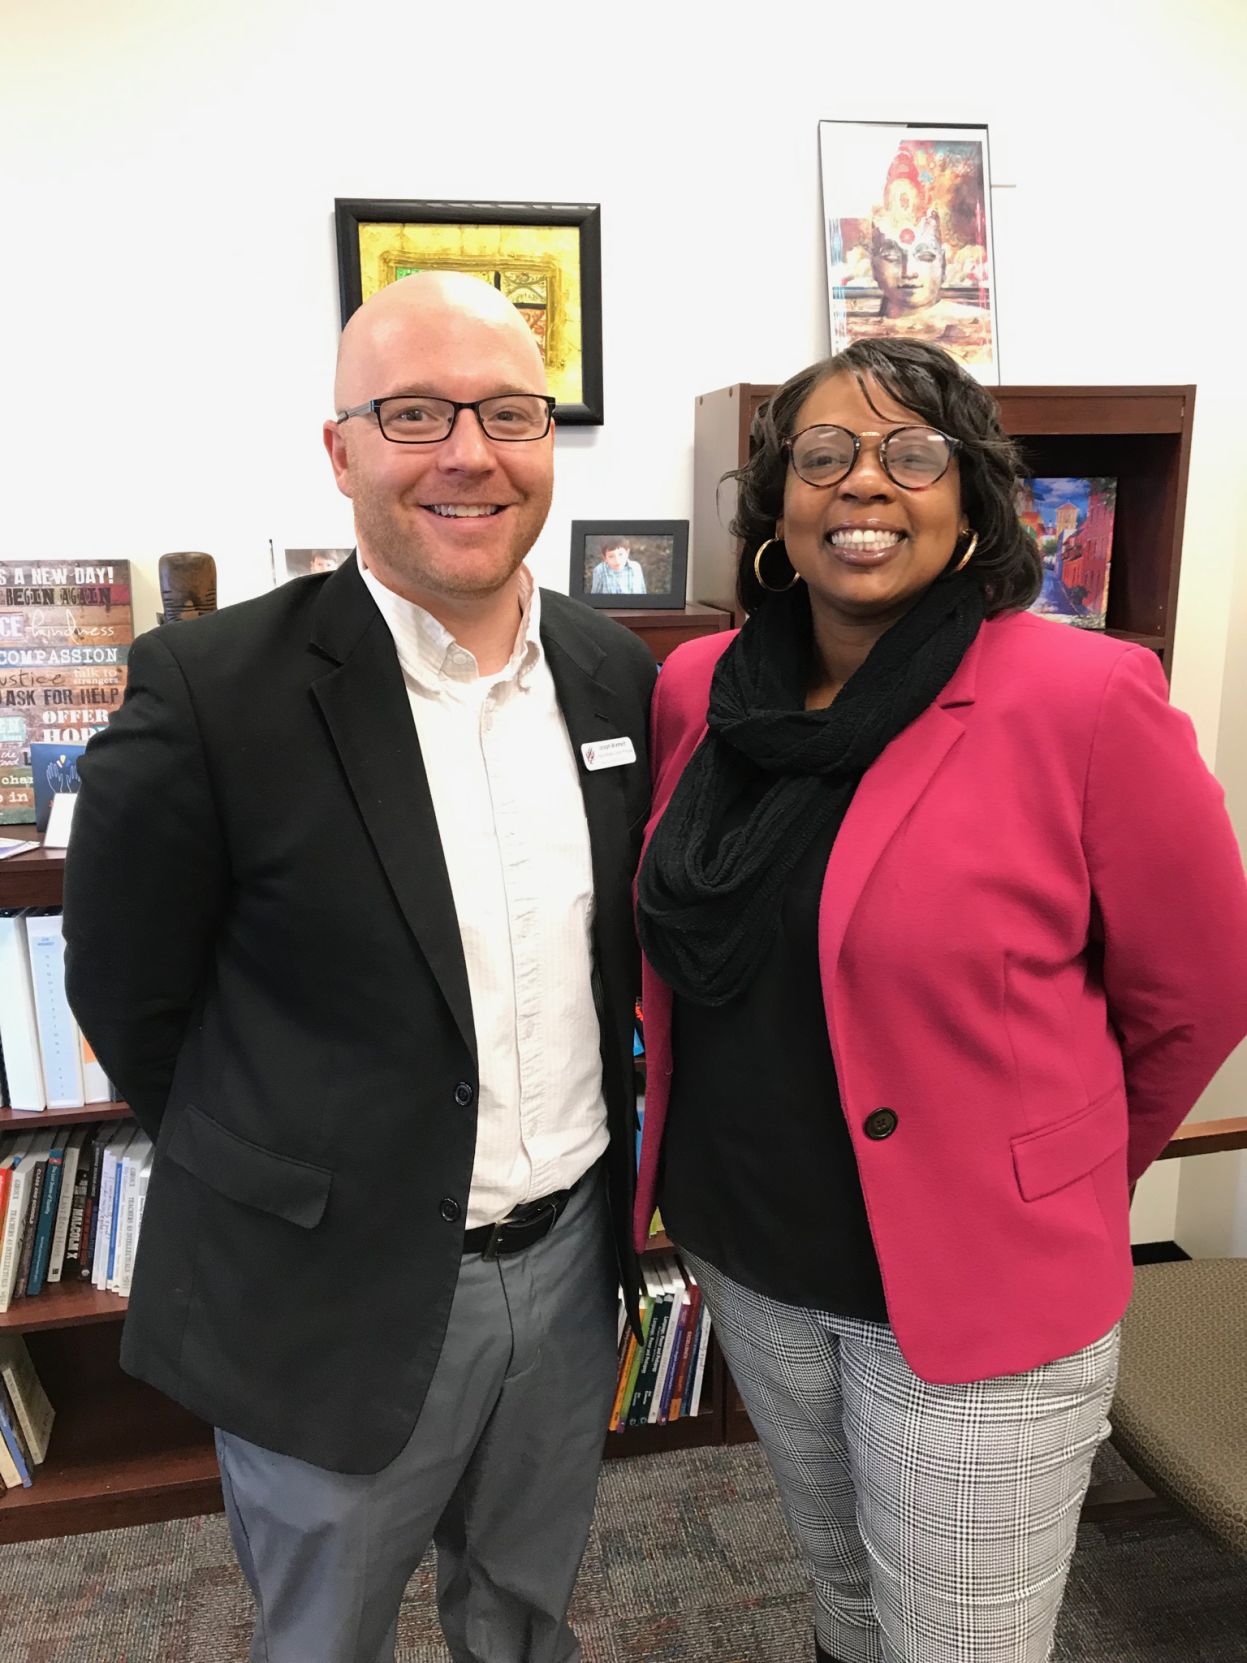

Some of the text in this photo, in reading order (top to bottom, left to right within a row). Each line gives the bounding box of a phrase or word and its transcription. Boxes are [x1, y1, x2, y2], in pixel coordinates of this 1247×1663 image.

[14, 567, 25, 585] A
[31, 567, 68, 585] NEW
[74, 566, 114, 585] DAY!
[6, 587, 111, 608] BEGIN AGAIN
[24, 608, 115, 645] kindness
[0, 648, 119, 665] COMPASSION
[73, 667, 118, 678] talk to
[6, 687, 119, 706] ASK FOR HELP
[42, 709, 109, 724] OFFER
[43, 727, 106, 742] HOP
[9, 791, 29, 802] in
[67, 1207, 84, 1252] MALCOLM
[66, 1251, 78, 1260] X
